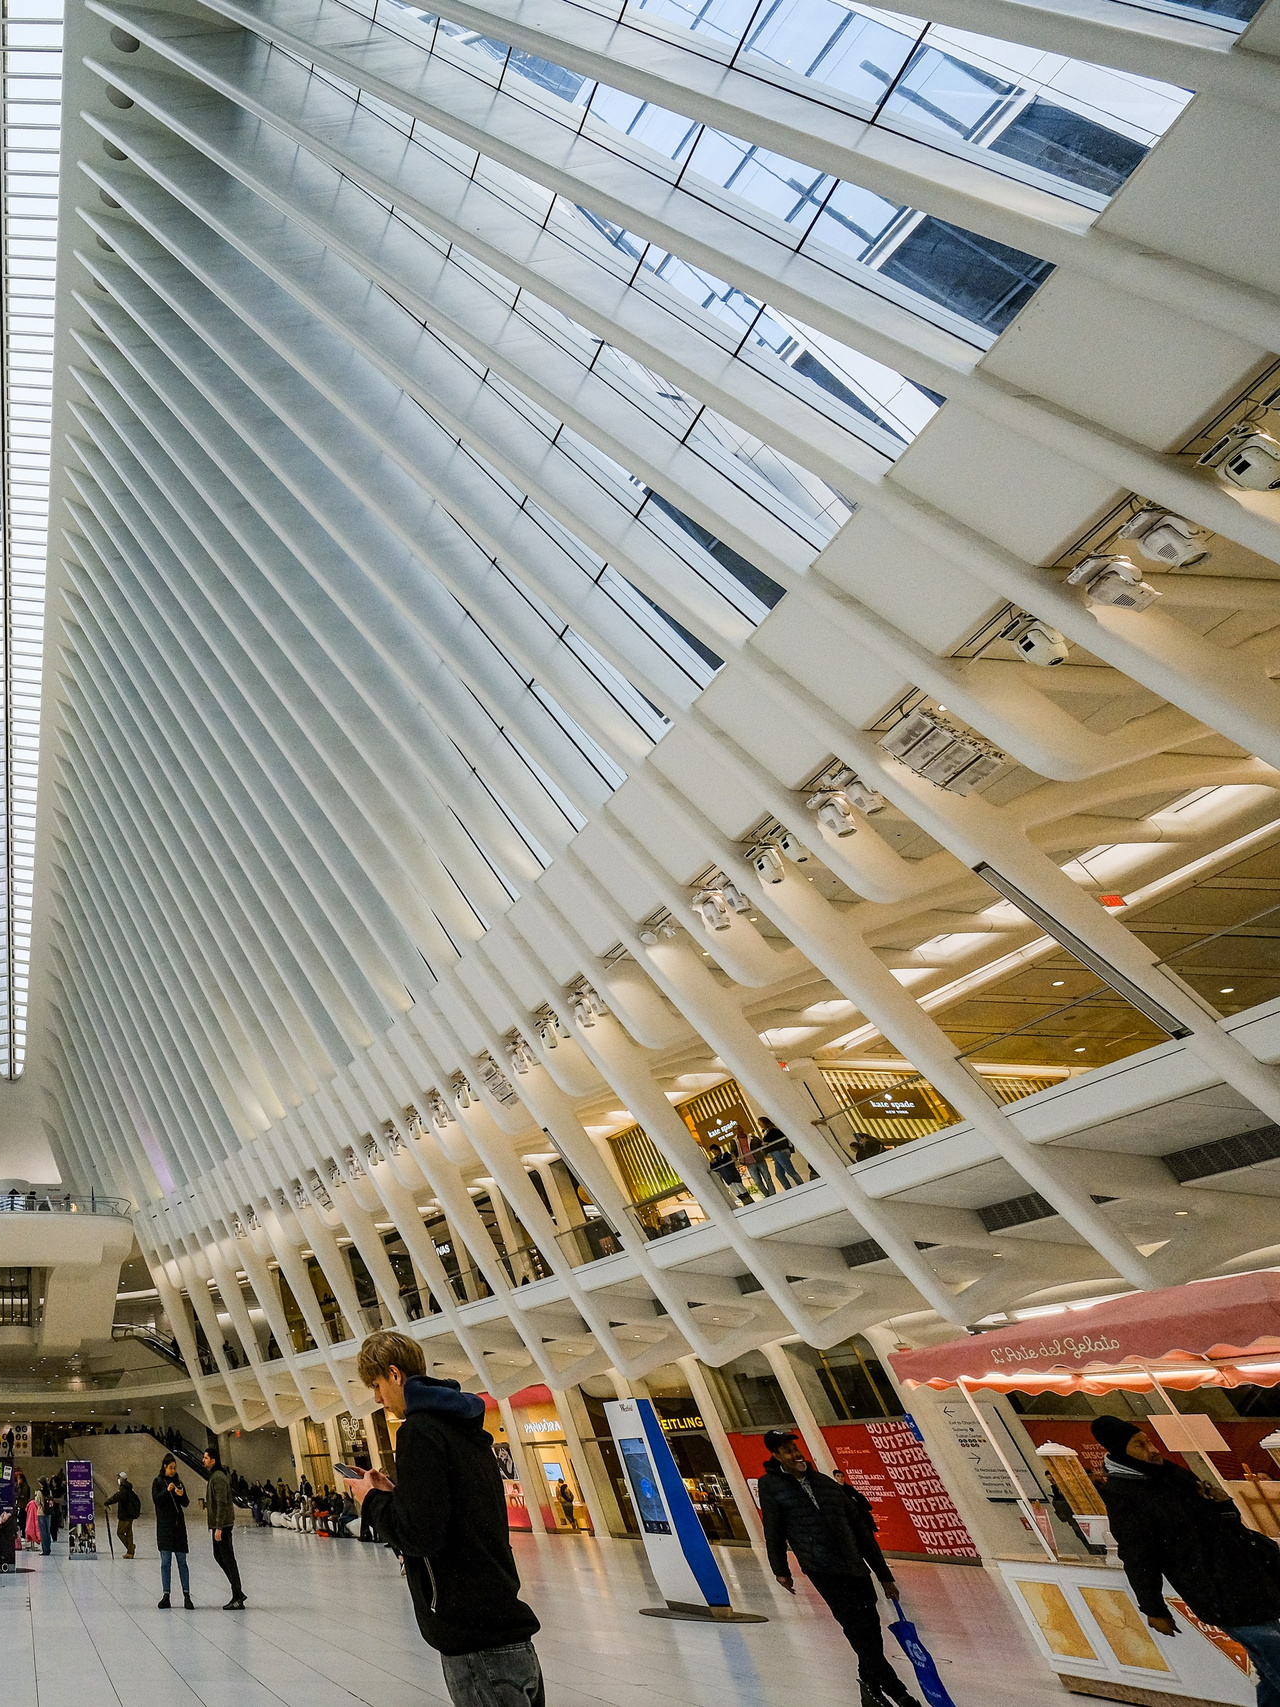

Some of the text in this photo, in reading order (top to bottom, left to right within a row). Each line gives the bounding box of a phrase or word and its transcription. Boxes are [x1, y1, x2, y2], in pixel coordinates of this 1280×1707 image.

[869, 1100, 915, 1110] kate spade
[707, 1120, 738, 1138] kate spade
[991, 1345, 1039, 1364] L'Arte
[1039, 1340, 1066, 1356] del
[524, 1418, 561, 1433] PANDORA
[660, 1416, 704, 1430] EITLING
[871, 1436, 896, 1449] BUT
[878, 1450, 904, 1465] BUT
[886, 1466, 912, 1481] BUT
[893, 1481, 920, 1496] BUT
[901, 1497, 929, 1512] BUT
[909, 1513, 937, 1529] BUT
[917, 1529, 946, 1546] BUT
